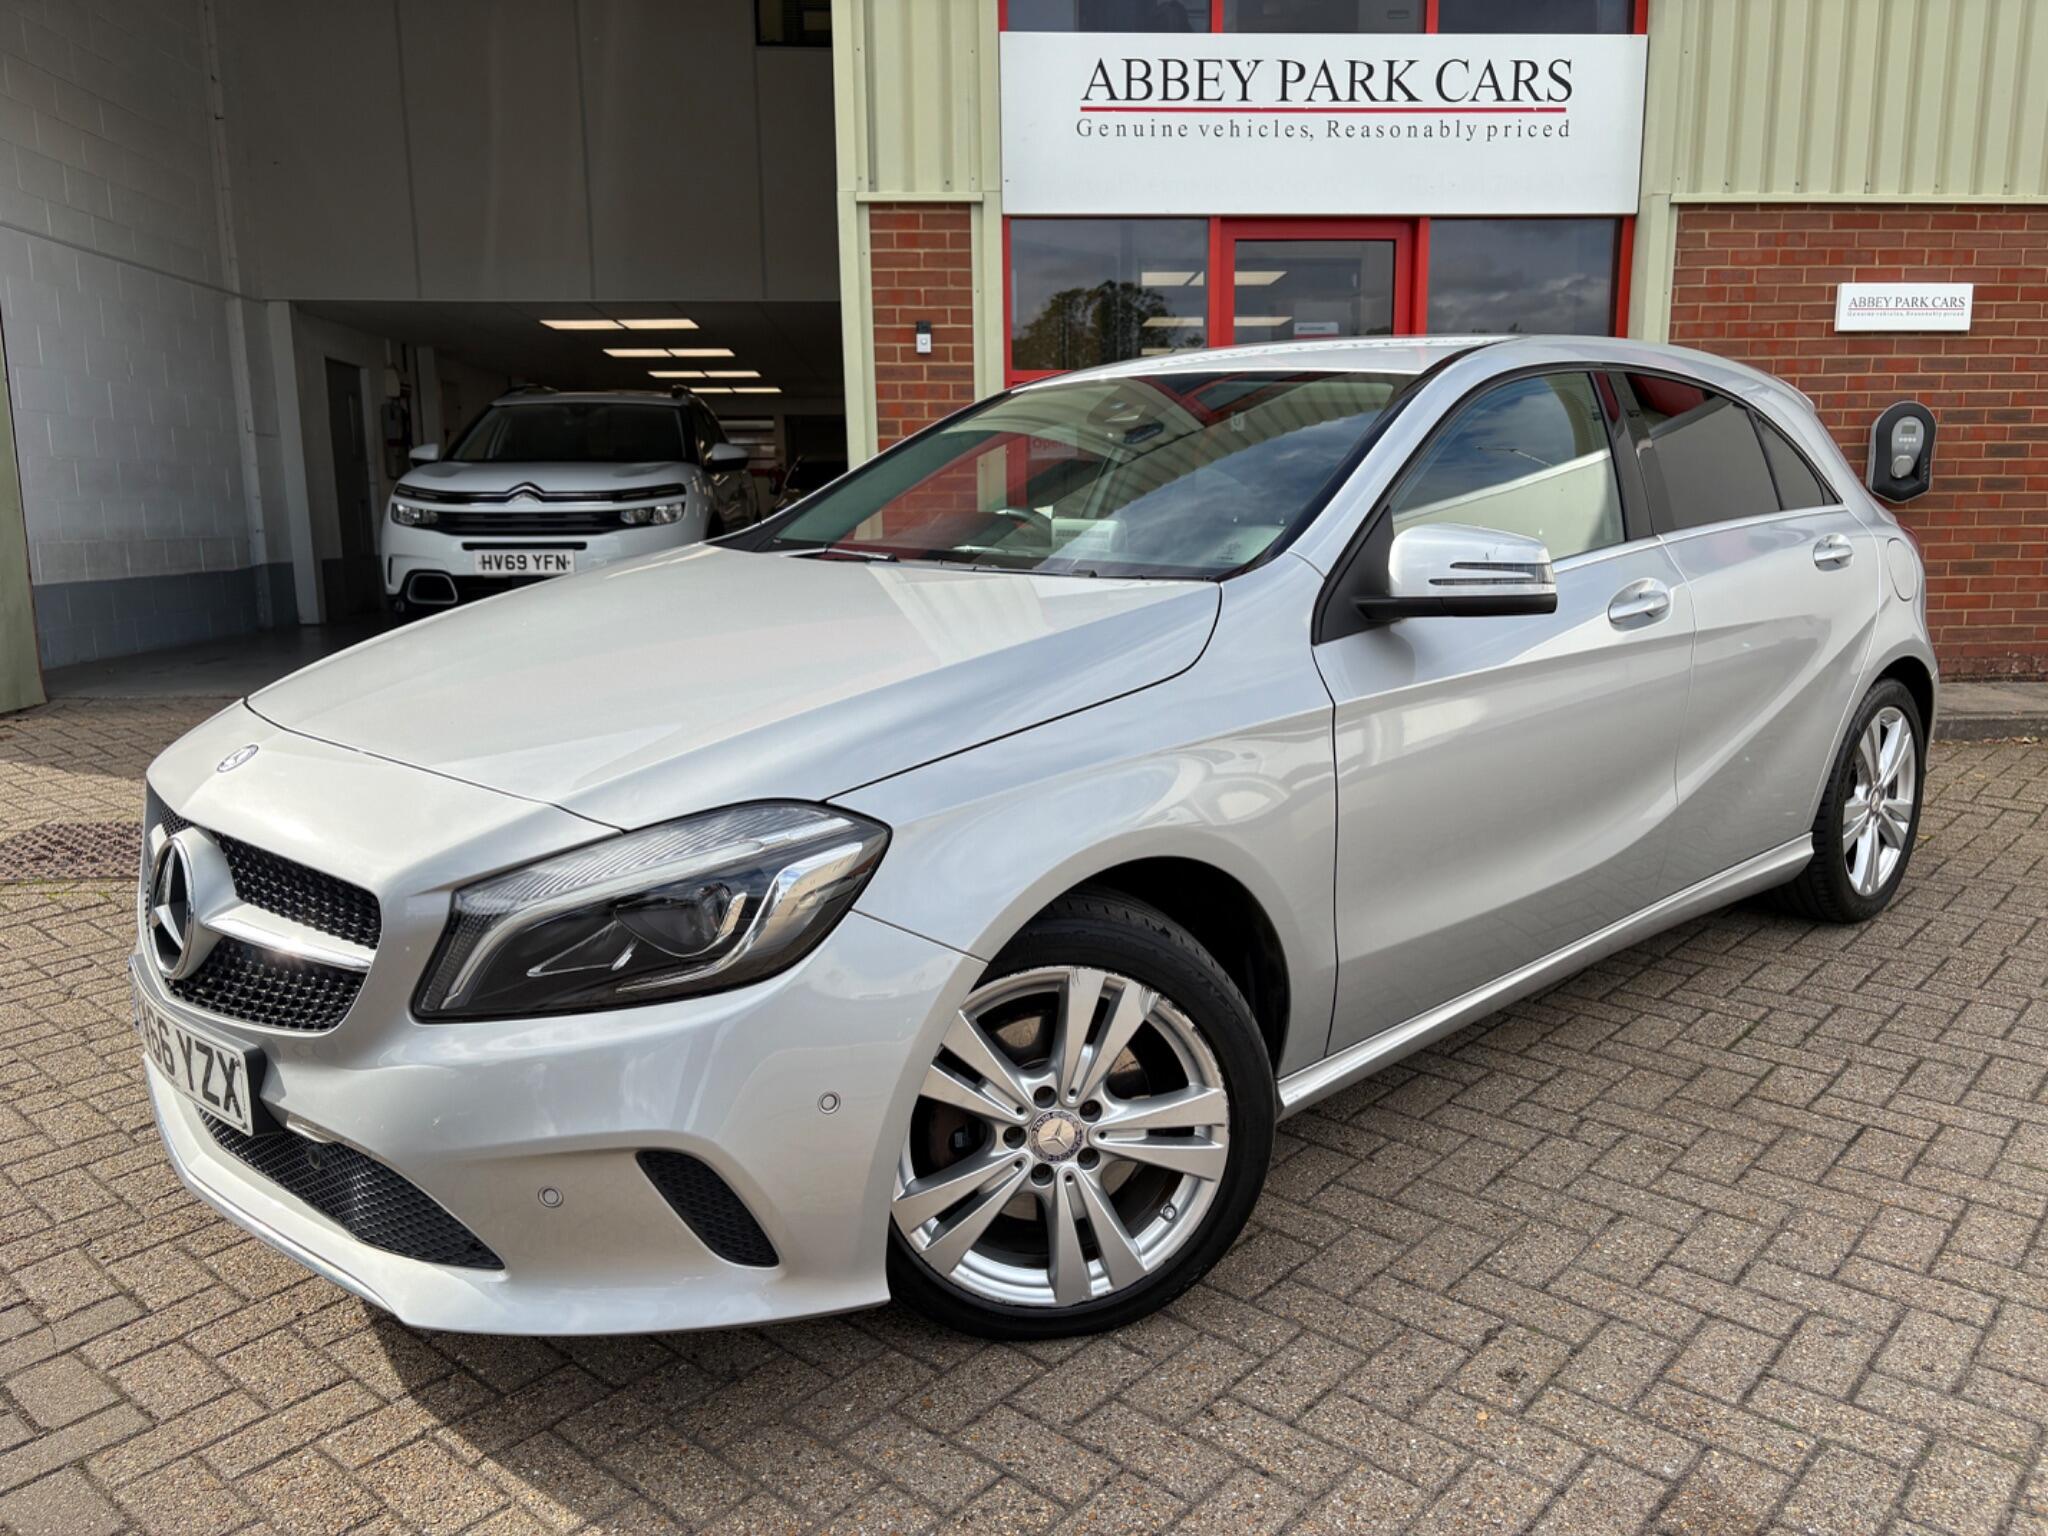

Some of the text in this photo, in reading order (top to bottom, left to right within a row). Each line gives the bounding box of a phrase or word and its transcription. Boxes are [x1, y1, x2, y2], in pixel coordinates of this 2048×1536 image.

[1081, 57, 1573, 103] ABBEY PARK CARS
[1076, 118, 1570, 142] Genuine vehicles, Reasonably priced
[1848, 296, 1966, 308] ABBEY PARK CARS
[481, 554, 567, 570] HV69 YFN
[139, 1000, 243, 1119] 66 YZX
